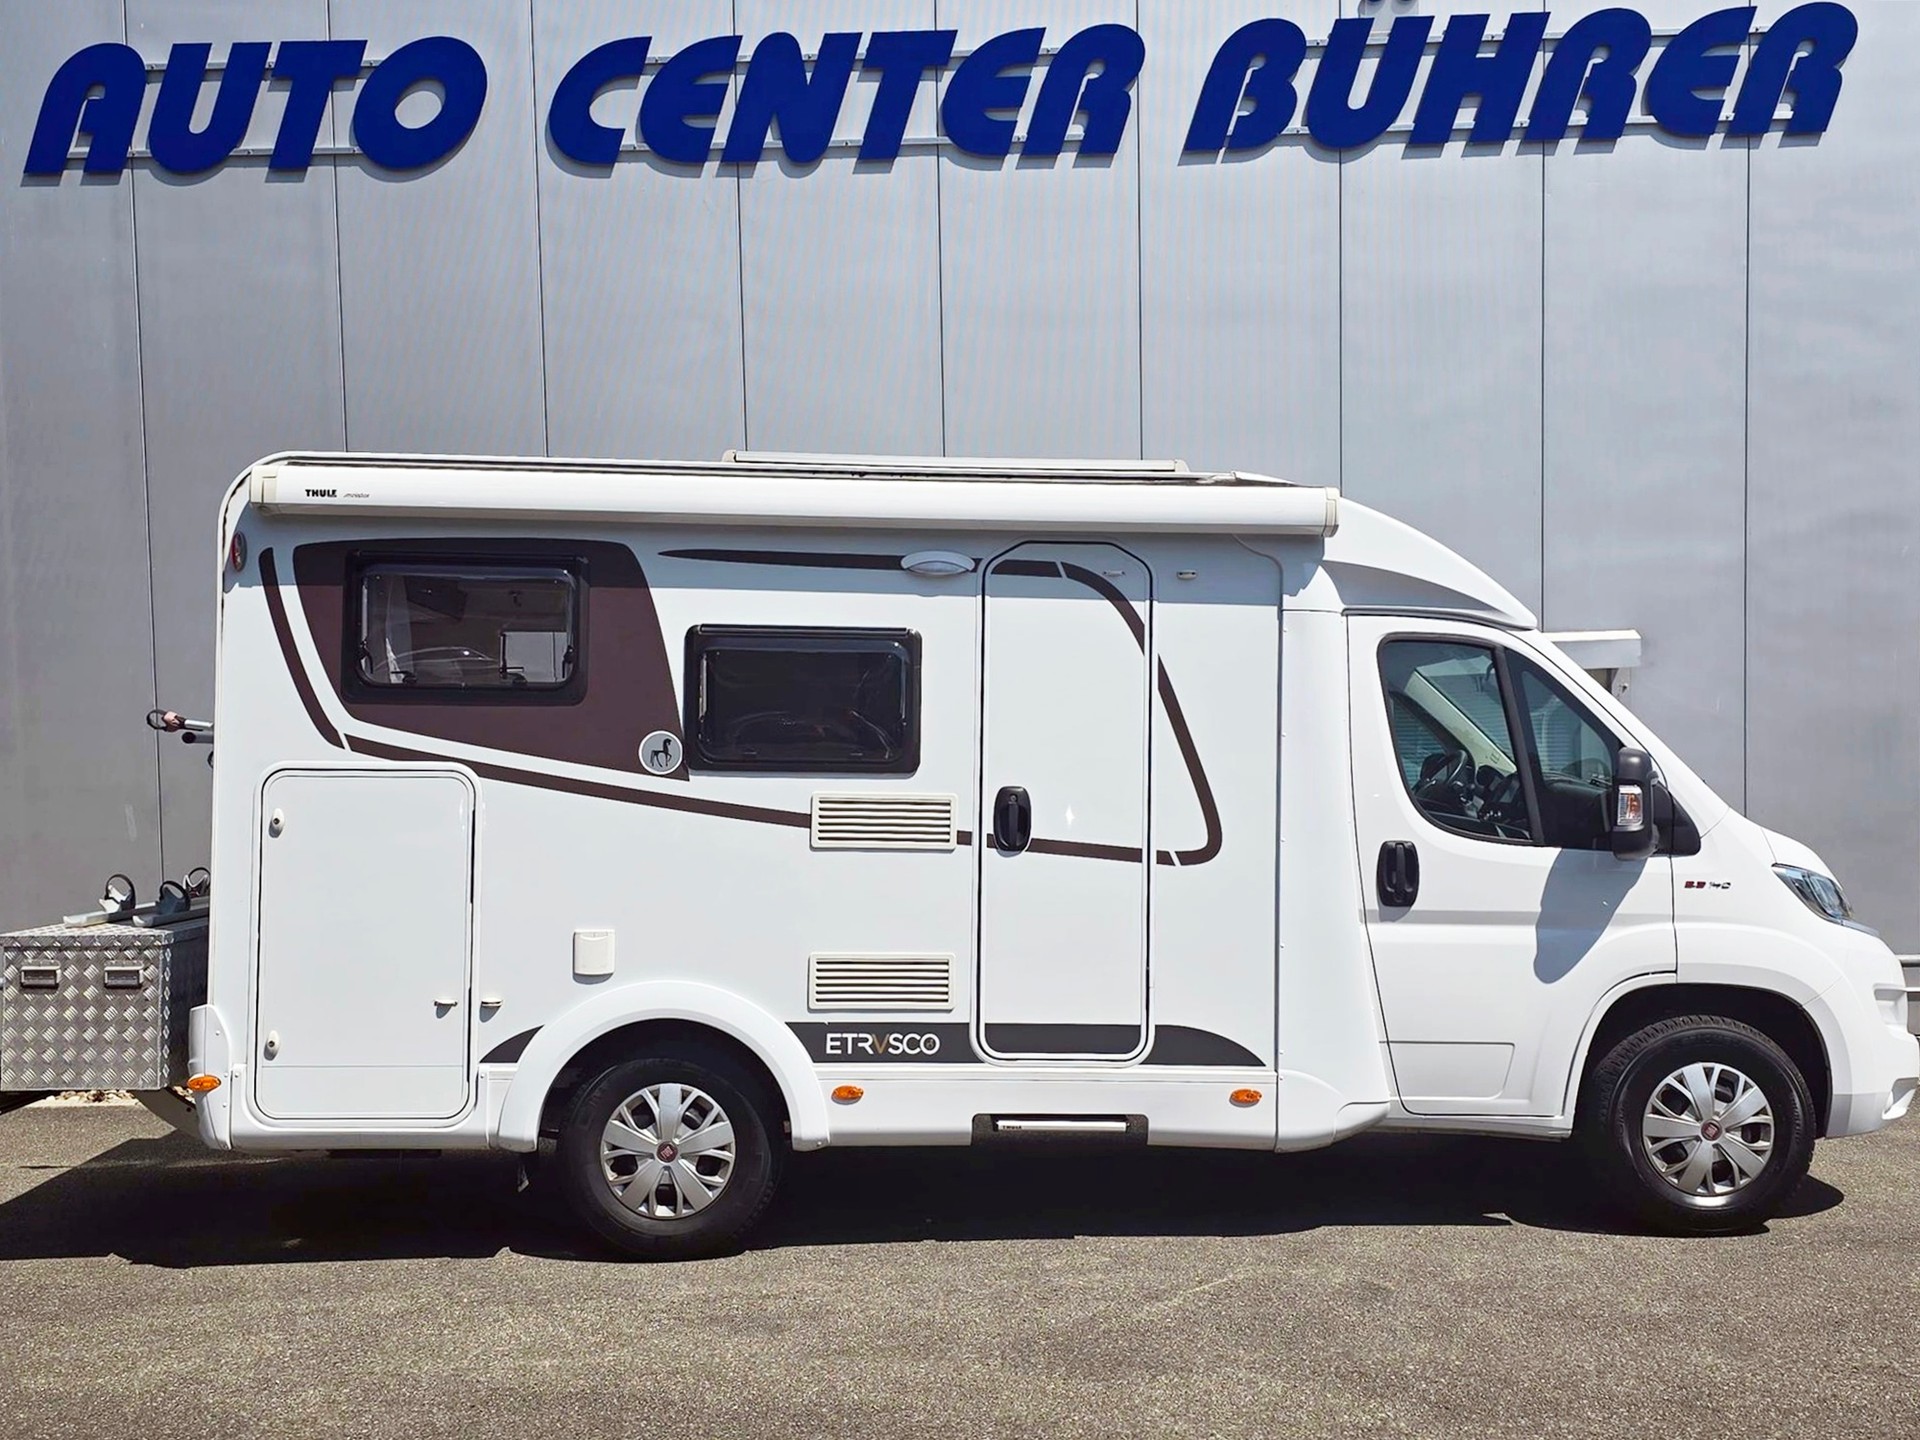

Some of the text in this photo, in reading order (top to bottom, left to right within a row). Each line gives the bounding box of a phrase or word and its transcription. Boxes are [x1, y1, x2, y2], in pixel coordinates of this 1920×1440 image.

[24, 36, 488, 174] AUTO
[548, 23, 1146, 165] CENTER
[305, 489, 338, 498] THULE
